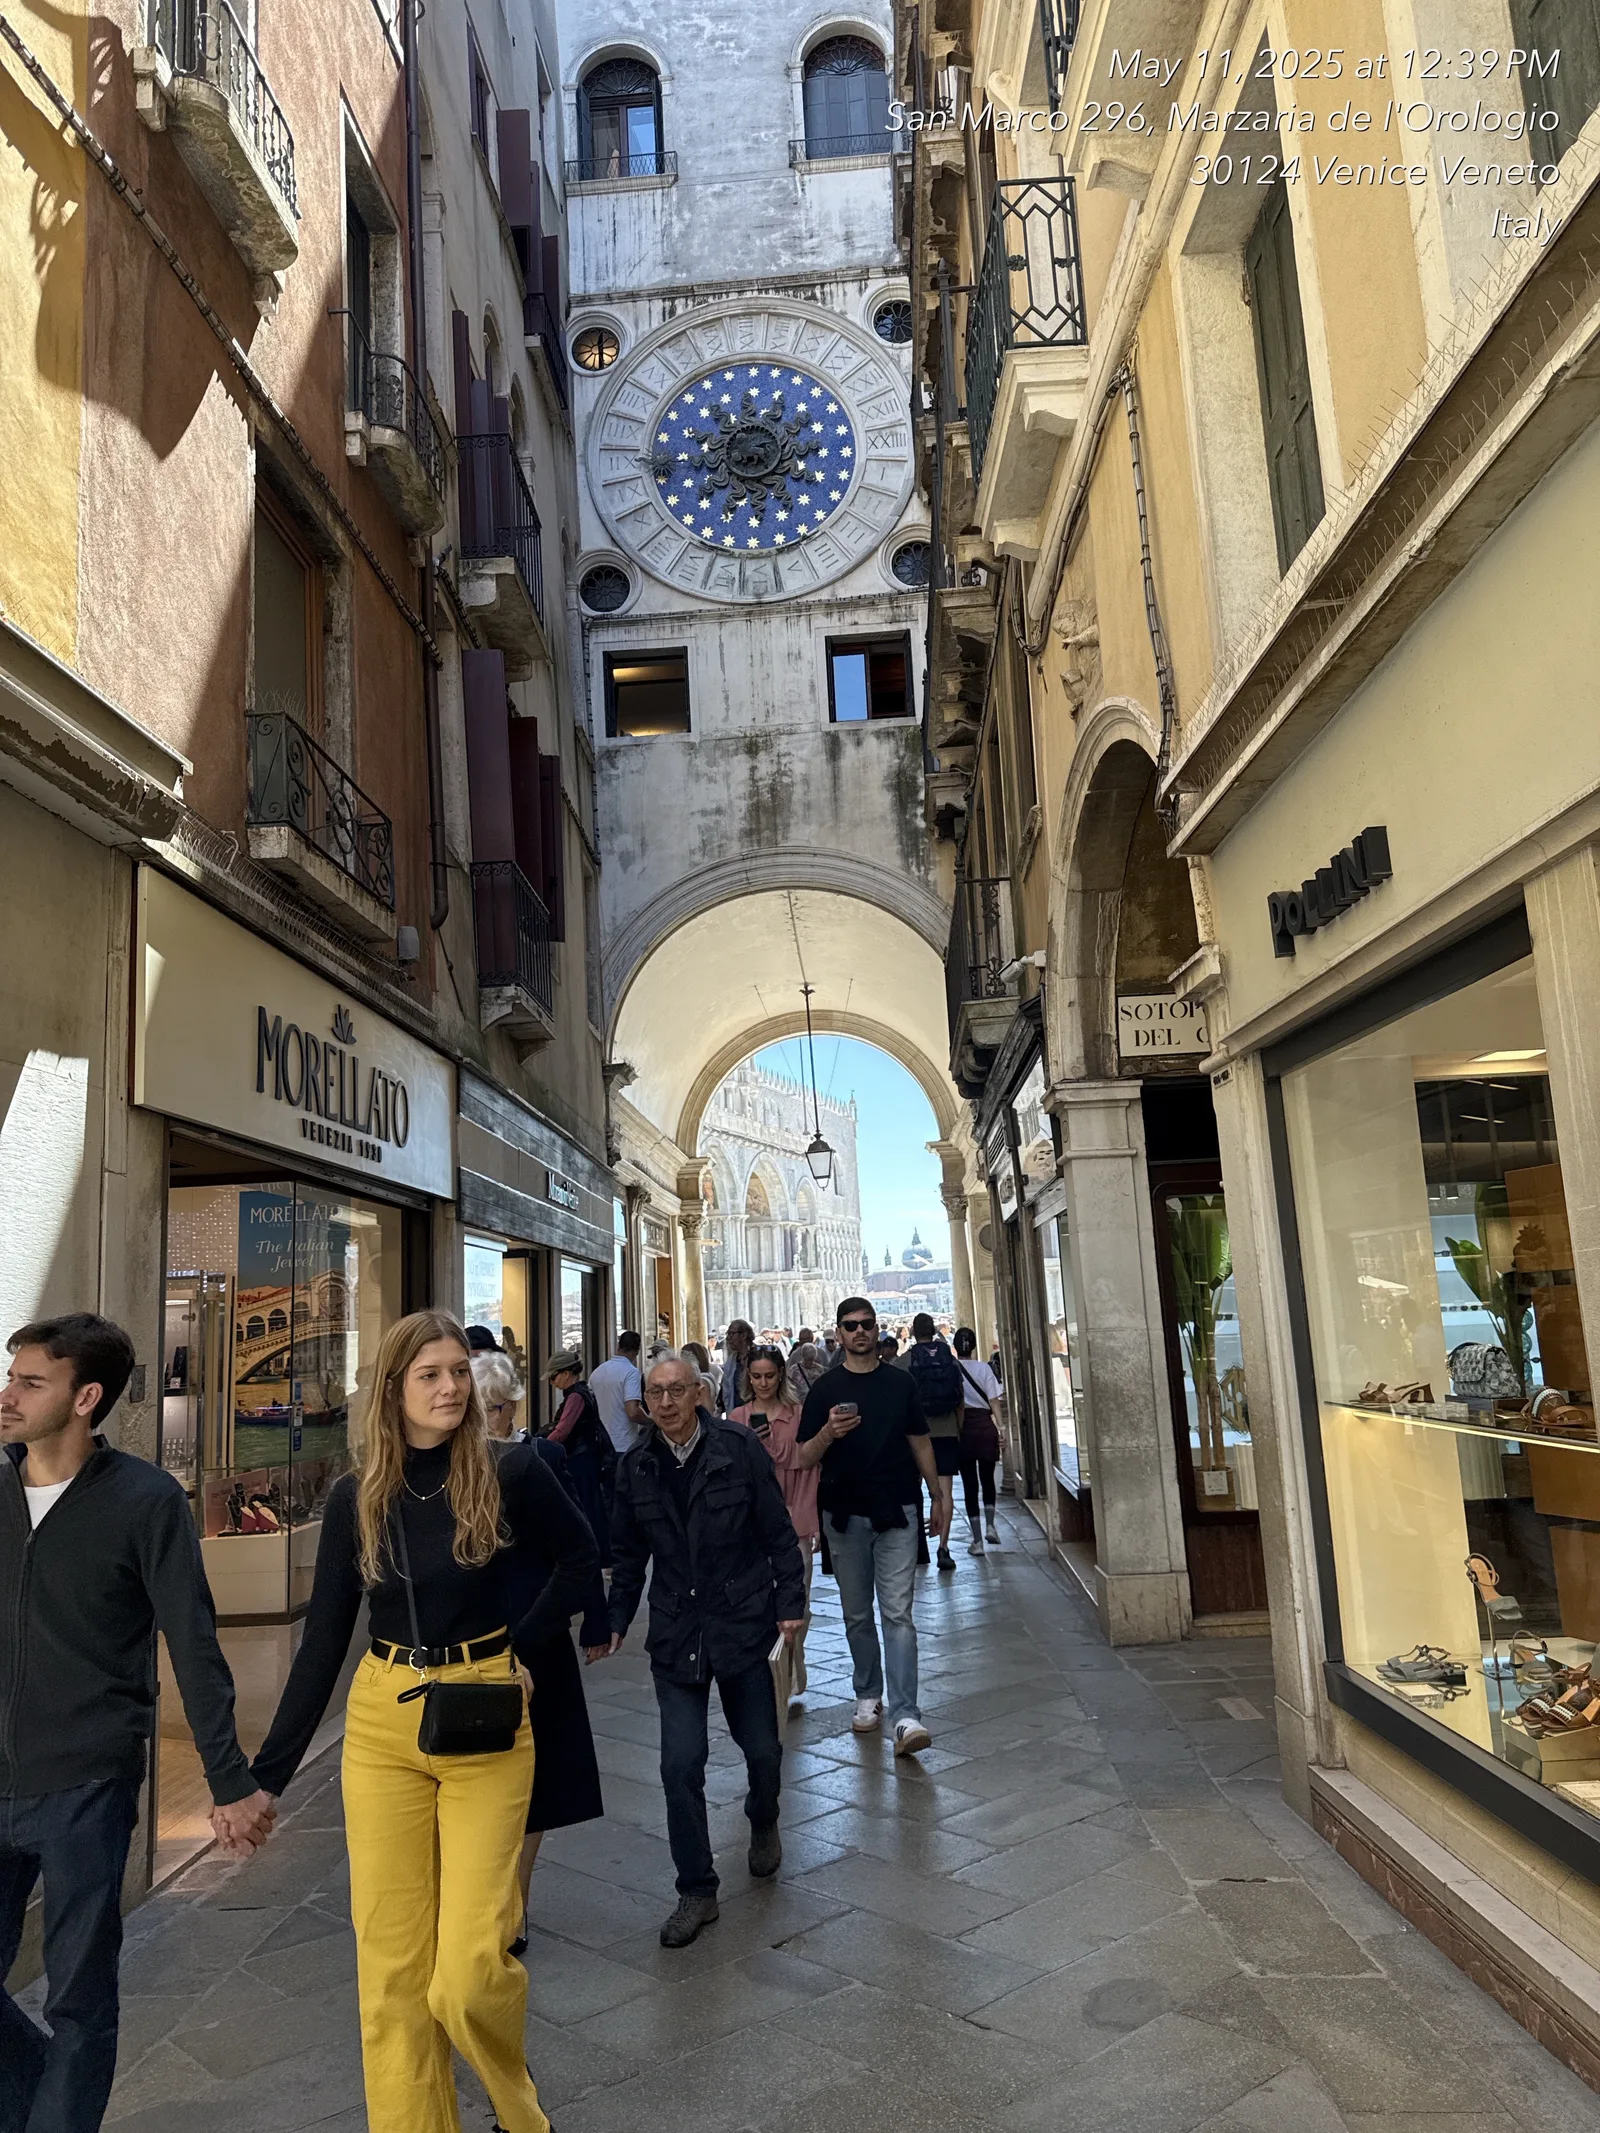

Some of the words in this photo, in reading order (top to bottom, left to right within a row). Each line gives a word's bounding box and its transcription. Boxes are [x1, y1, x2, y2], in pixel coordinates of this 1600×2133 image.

[1267, 825, 1393, 959] POLLINI
[1134, 1028, 1180, 1047] DEL
[256, 1005, 409, 1148] MORELLATO
[301, 1118, 353, 1153] VENEZIA
[250, 1205, 343, 1224] MORELLATO
[255, 1240, 283, 1254] The
[287, 1239, 335, 1252] Italian
[270, 1254, 314, 1273] Jewel
